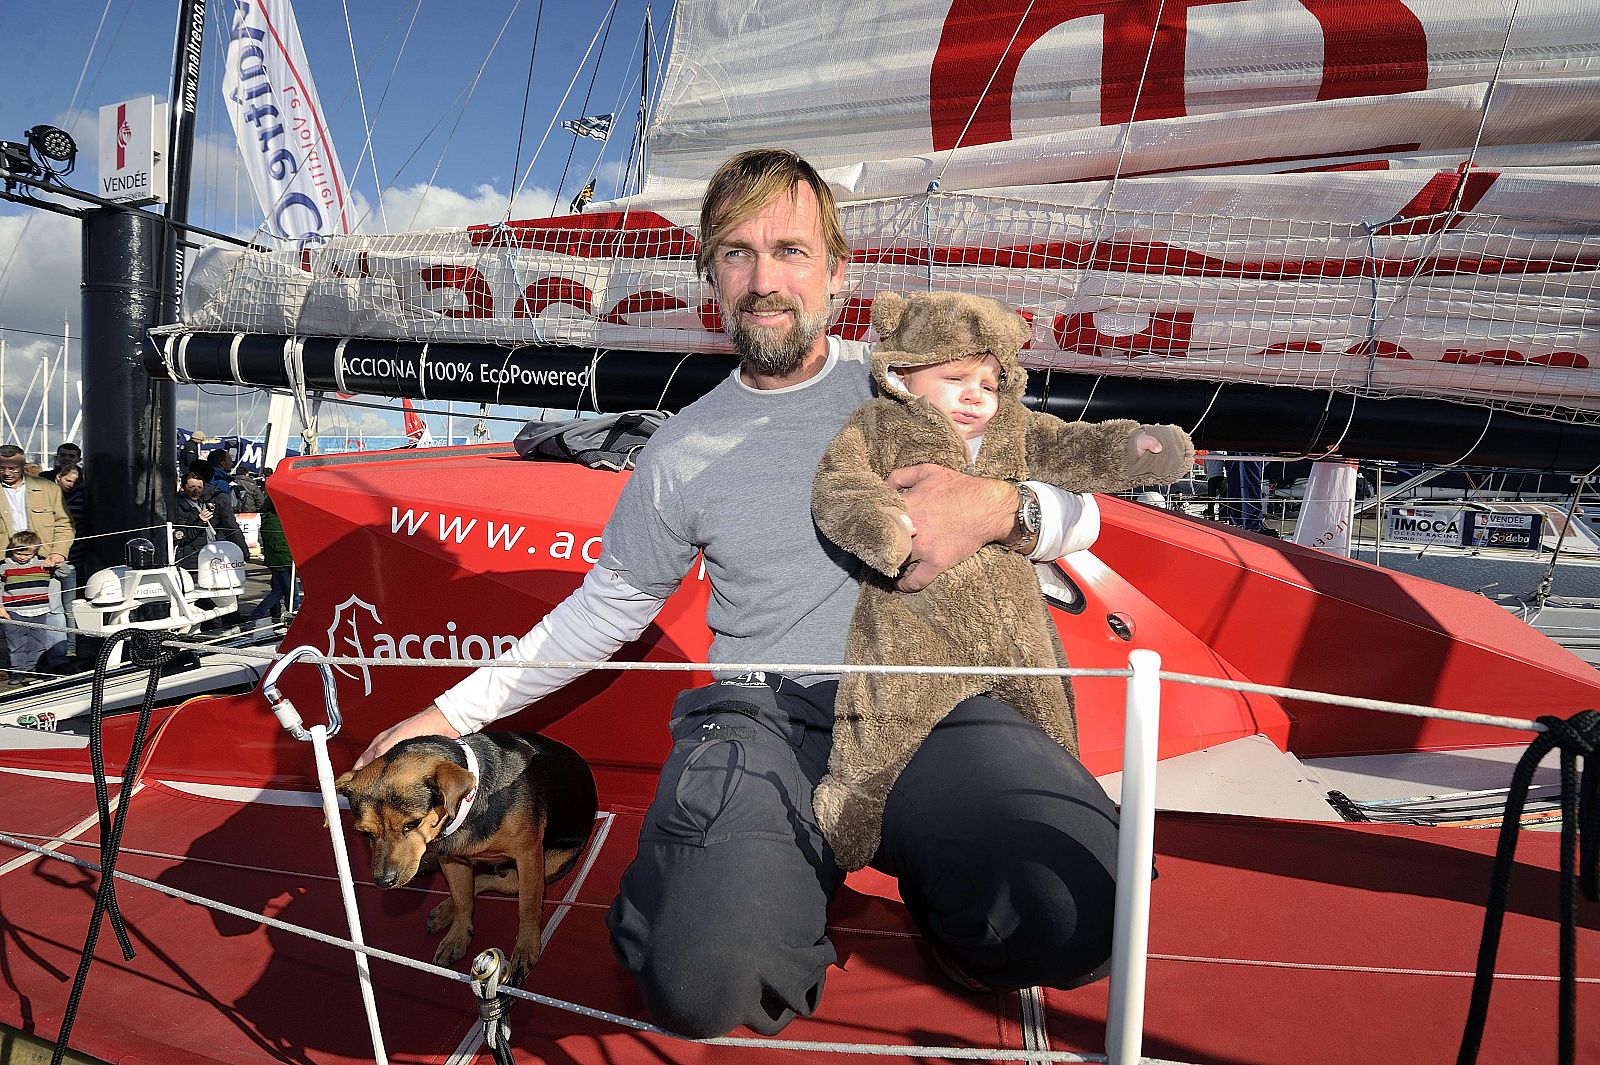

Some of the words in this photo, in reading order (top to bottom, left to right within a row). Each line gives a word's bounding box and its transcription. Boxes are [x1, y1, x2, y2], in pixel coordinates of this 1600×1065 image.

[103, 170, 148, 193] VENDÉE
[341, 357, 417, 379] ACCIONA
[426, 362, 474, 383] 100%
[480, 363, 590, 387] EcoPowered
[1394, 518, 1459, 534] IMOCA
[1490, 515, 1525, 524] VENDÉE
[391, 506, 603, 565] www.ac
[373, 621, 520, 662] accion
